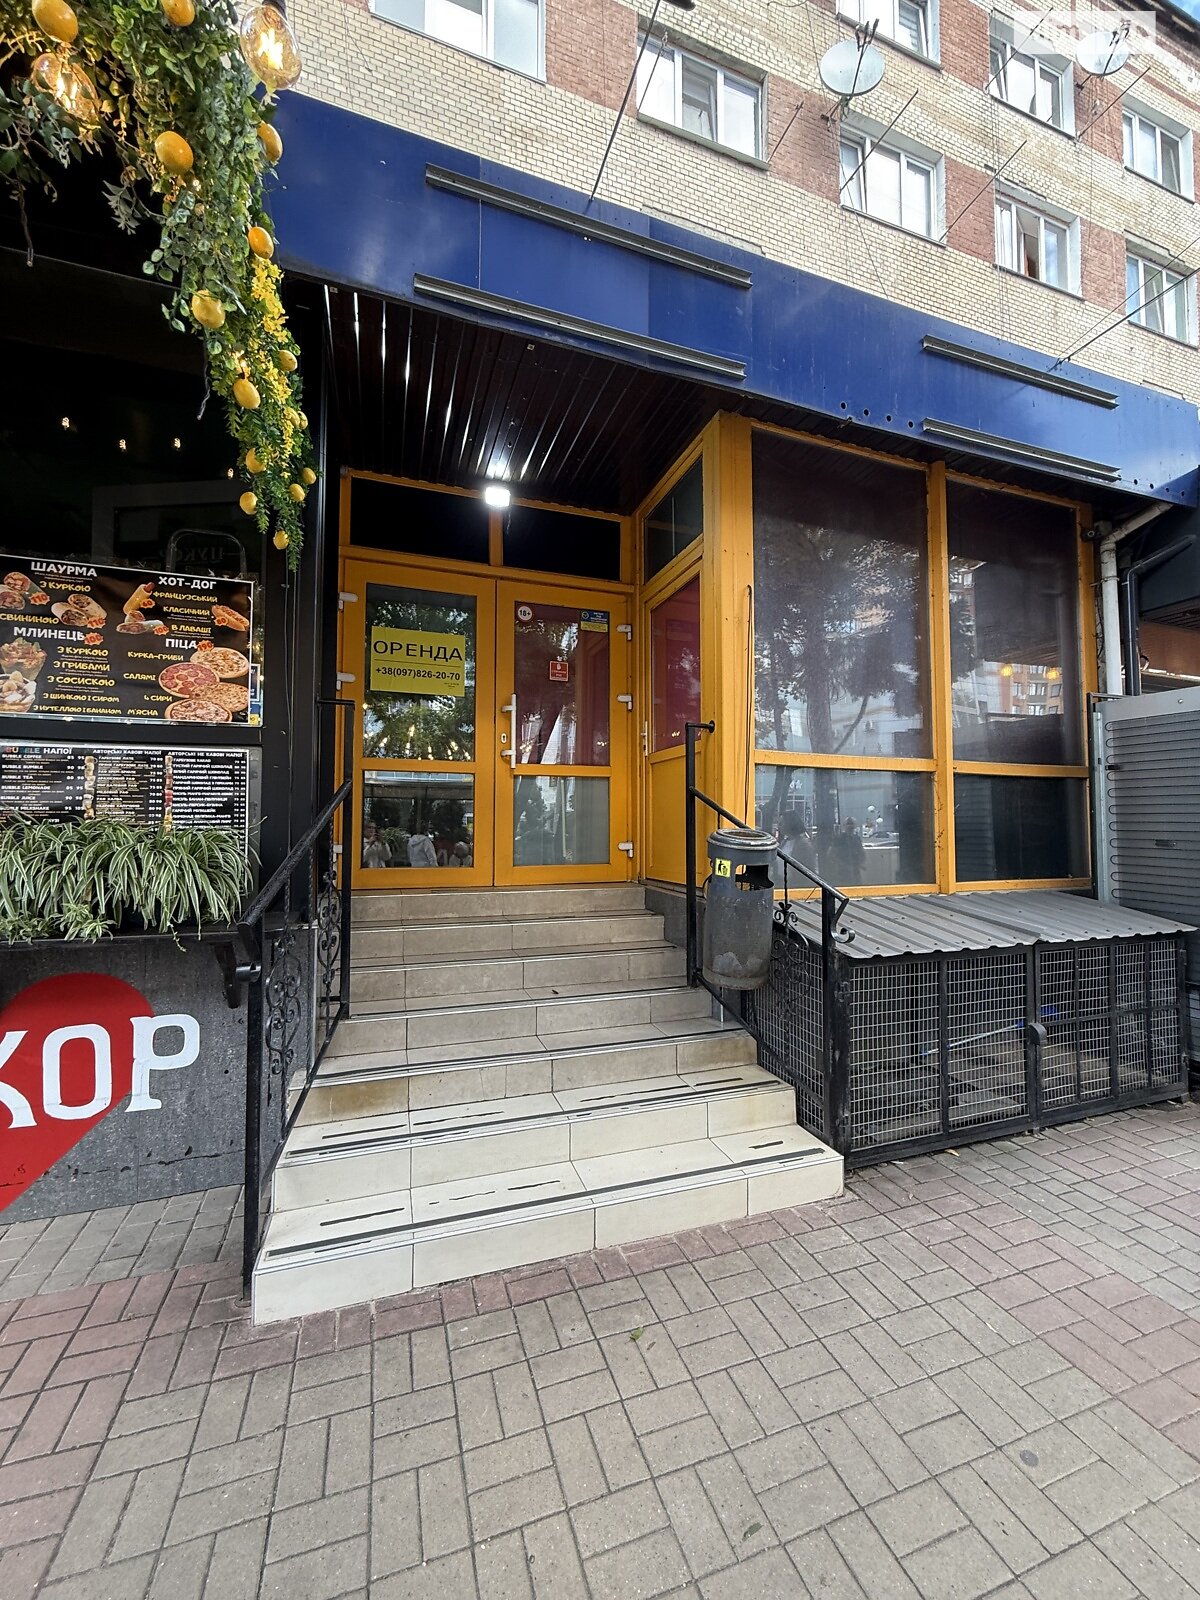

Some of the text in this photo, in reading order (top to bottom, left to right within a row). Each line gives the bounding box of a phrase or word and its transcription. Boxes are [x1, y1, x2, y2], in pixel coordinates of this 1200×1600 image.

[31, 561, 98, 577] ШАУРМА
[39, 580, 91, 592] З КУРКОЮ
[158, 576, 217, 590] ХОТ-ДОГ
[31, 593, 48, 603] 110
[153, 591, 218, 603] ФРАНЦУЗСЬКИЙ
[163, 606, 210, 616] КЛАСИЧНИЙ
[519, 609, 531, 617] 18+
[0, 613, 59, 625] СВИНИНОЮ
[13, 626, 85, 641] МЛИНЕЦЬ
[179, 625, 212, 634] ЛАВАШІ
[85, 634, 103, 644] 100
[165, 638, 198, 650] ПІЦА
[57, 646, 109, 657] З КУРКОЮ
[127, 651, 184, 662] КУРКА-ГРИБИ
[373, 640, 463, 662] ОРЕНДА
[53, 660, 110, 672] З ГРИБАМИ
[123, 672, 156, 681] САЛЯМІ
[376, 666, 460, 681] +38(097)826-20-70
[47, 675, 116, 687] З СОСИСКОЮ
[49, 693, 87, 701] ШИНКОЮ
[43, 747, 73, 755] НАПОЇ
